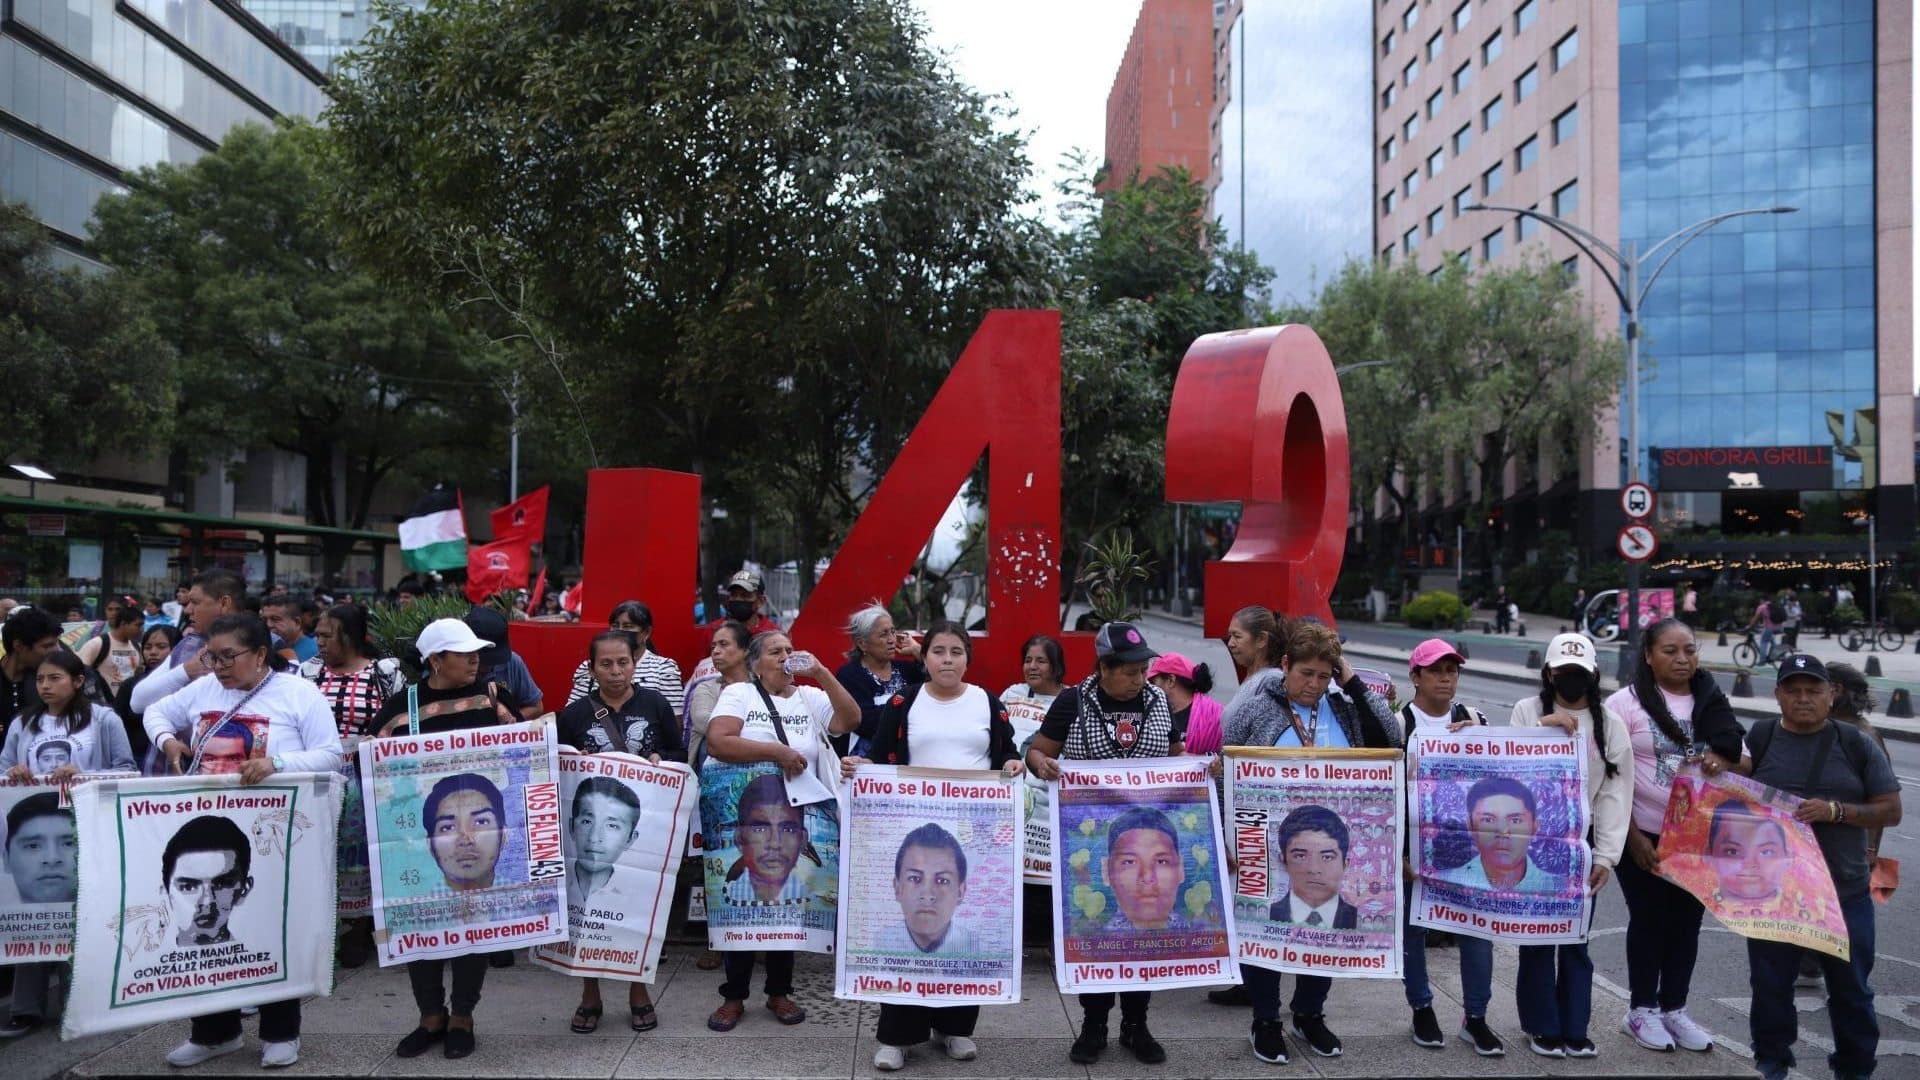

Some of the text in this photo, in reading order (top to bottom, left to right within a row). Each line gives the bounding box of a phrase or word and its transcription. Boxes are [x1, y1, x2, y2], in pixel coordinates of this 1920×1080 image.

[1661, 447, 1830, 466] SONORA GRILL
[374, 740, 419, 762] ¡Vivo
[424, 739, 445, 751] se
[450, 734, 466, 750] lo
[471, 728, 545, 748] llevaron!
[1421, 739, 1575, 756] ¡Vivo se lo llevaron!
[559, 757, 577, 772] ivo
[579, 759, 595, 773] se
[600, 761, 614, 776] lo
[618, 764, 681, 789] llevaron!
[1060, 768, 1207, 789] ¡Vivo se lo llevaron!
[1236, 761, 1393, 781] ¡Vivo se lo llevaron!
[853, 778, 1011, 799] ¡Vivo se lo llevaron!
[127, 794, 287, 819] ¡Vivo se lo llevaron!
[395, 812, 417, 830] 43
[527, 783, 565, 882] NOS FALTAN 43!
[1235, 807, 1268, 897] NOS FALTAN 43!
[707, 857, 725, 877] 43
[399, 868, 421, 887] 43
[0, 911, 33, 921] ARTÍN
[590, 908, 624, 922] PABLO
[1533, 901, 1579, 911] GUERRERO
[1428, 904, 1468, 923] ¡Vivo
[1472, 913, 1486, 928] lo
[1491, 920, 1572, 935] queremos!
[398, 933, 439, 955] ¡Vivo
[444, 930, 460, 945] lo
[465, 915, 550, 941] queremos!
[724, 931, 808, 943] ¡Vivo lo queremos!
[1263, 925, 1292, 937] JORGE
[4, 942, 36, 957] VIDA
[39, 942, 52, 956] lo
[1068, 941, 1092, 951] LUIS
[1133, 938, 1186, 949] FRANCISCO
[1191, 935, 1225, 946] ARZOLA
[160, 943, 249, 964] CÉSAR MANUEL
[579, 946, 639, 965] queremos!
[884, 958, 911, 967] JOVANY
[1238, 941, 1386, 969] ¡Vivo lo queremos!
[134, 952, 271, 979] GONZÁLEZ HERNÁNDEZ
[1074, 959, 1222, 984] ¡Vivo lo queremos!
[122, 961, 278, 1001] ¡Con VIDA lo queremos!
[853, 975, 1003, 998] ¡Vivo lo queremos!
